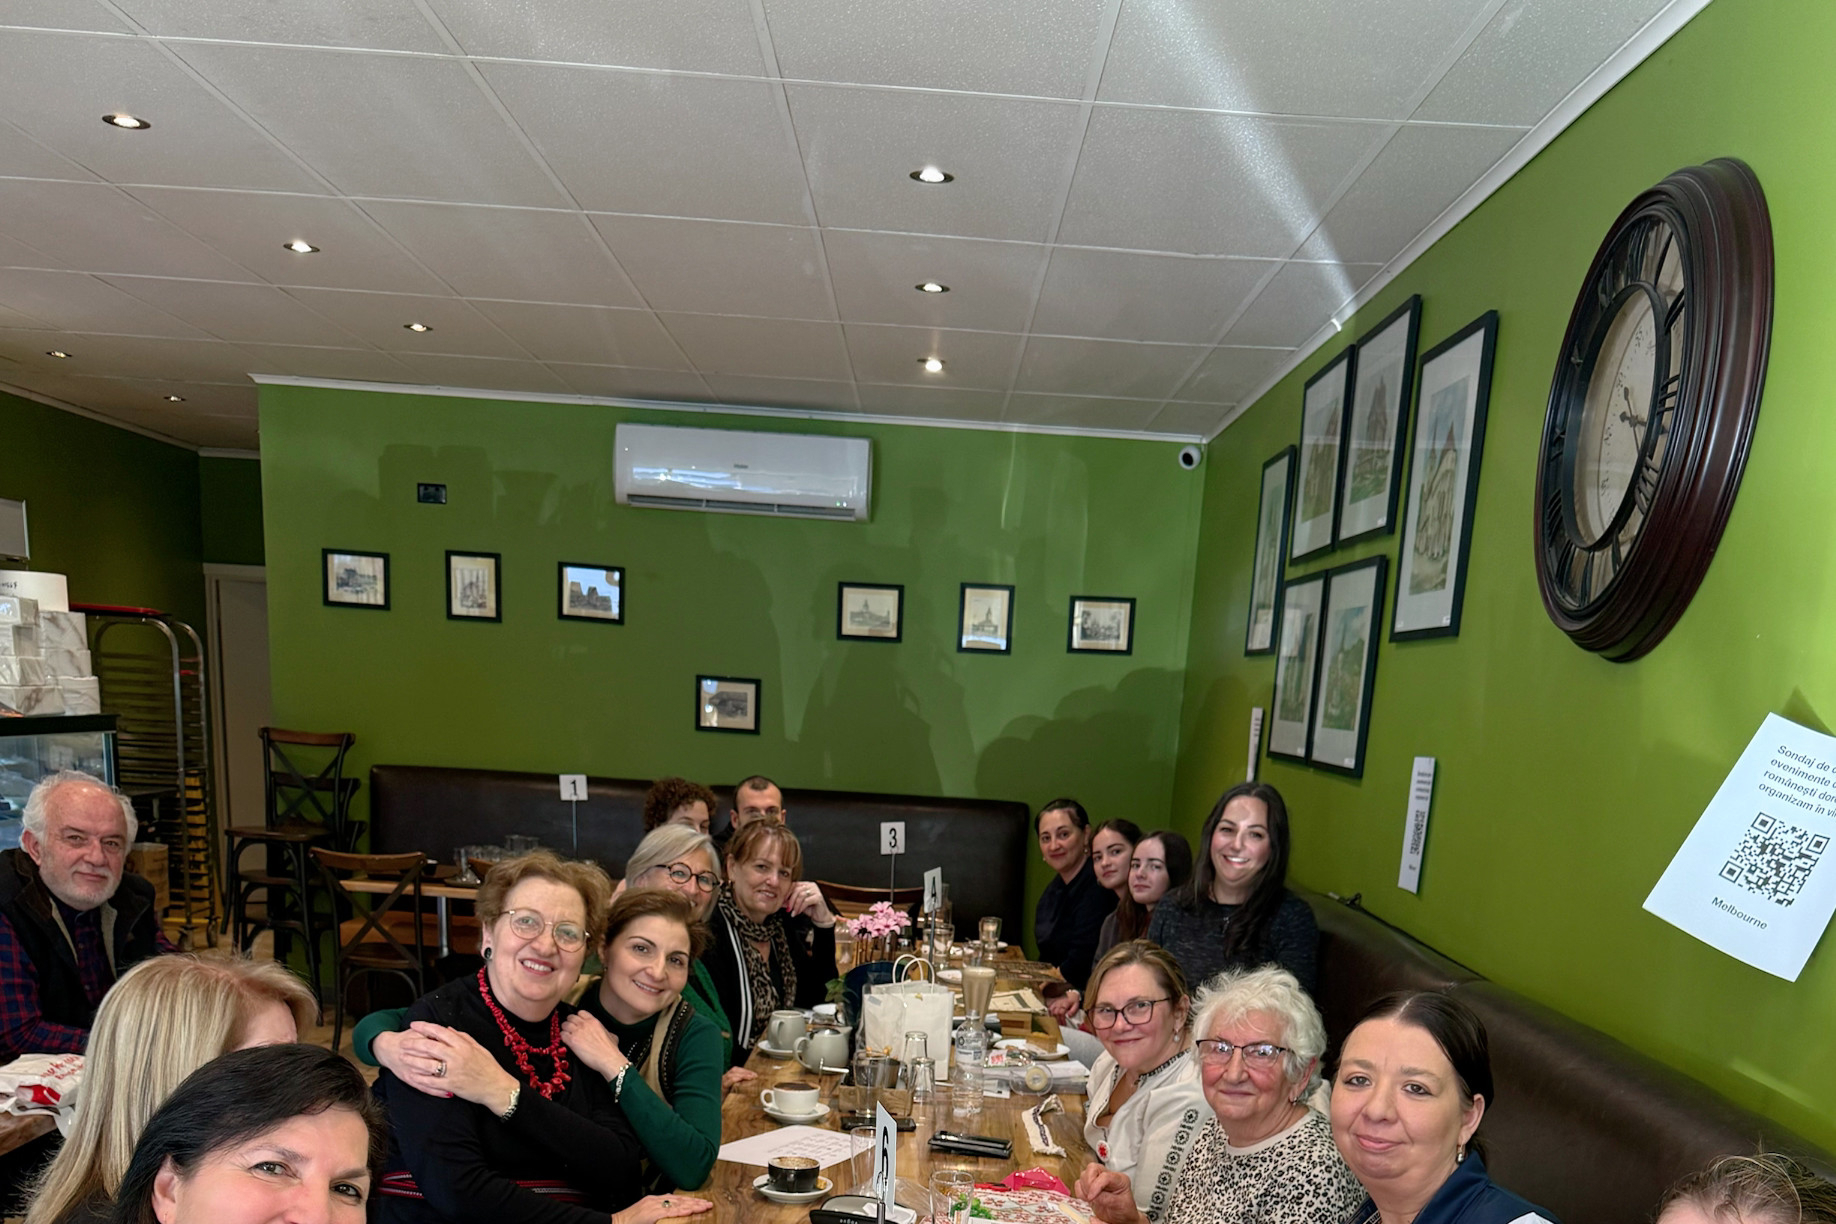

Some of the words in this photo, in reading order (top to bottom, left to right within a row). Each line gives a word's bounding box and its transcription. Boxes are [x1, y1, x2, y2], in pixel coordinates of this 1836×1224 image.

[1777, 745, 1817, 768] Sondaj
[1816, 761, 1830, 772] de
[1770, 759, 1831, 787] evenimente
[570, 780, 577, 796] 1
[889, 827, 897, 848] 3
[1711, 896, 1768, 930] Melbourne
